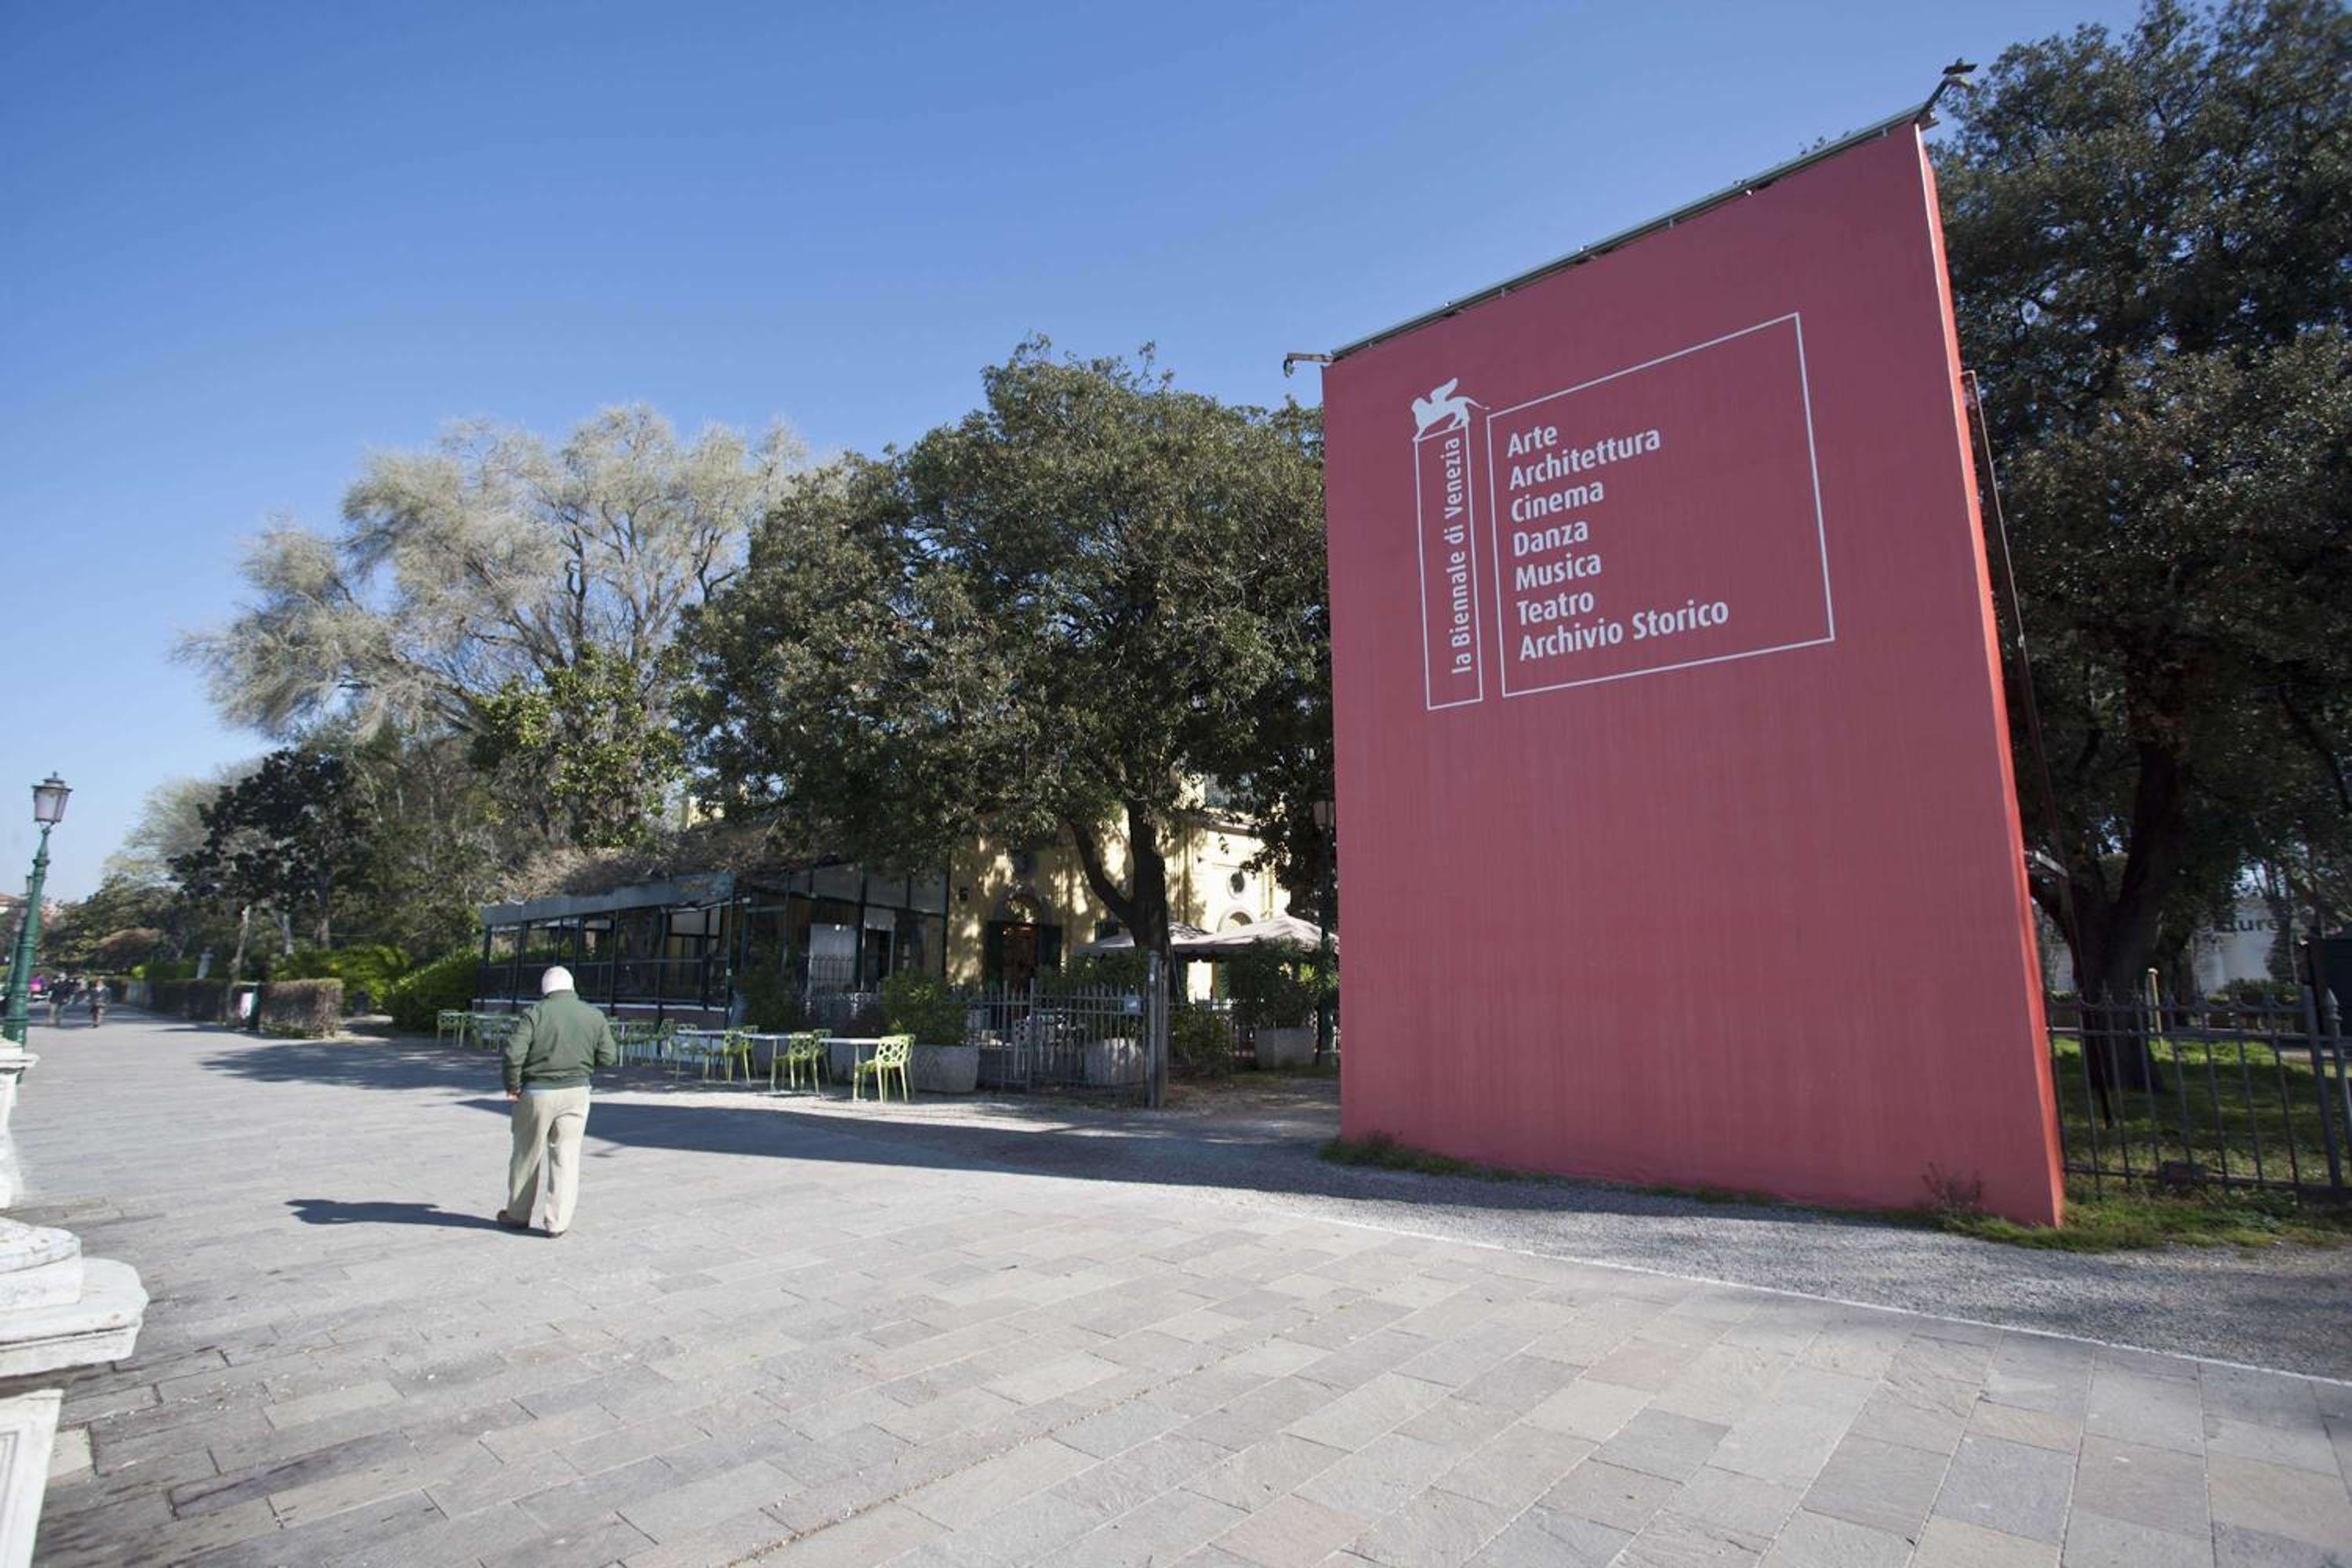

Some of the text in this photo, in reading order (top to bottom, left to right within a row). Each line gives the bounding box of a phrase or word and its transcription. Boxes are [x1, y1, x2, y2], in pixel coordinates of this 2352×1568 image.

[1507, 426, 1558, 459] Arte
[1509, 429, 1661, 491] Architettura
[1511, 481, 1604, 523] Cinema
[1439, 437, 1472, 674] la Biennale di Venezia
[1513, 521, 1589, 557] Danza
[1515, 554, 1602, 592] Musica
[1516, 592, 1595, 626] Teatro
[1519, 599, 1729, 662] Archivio Storico
